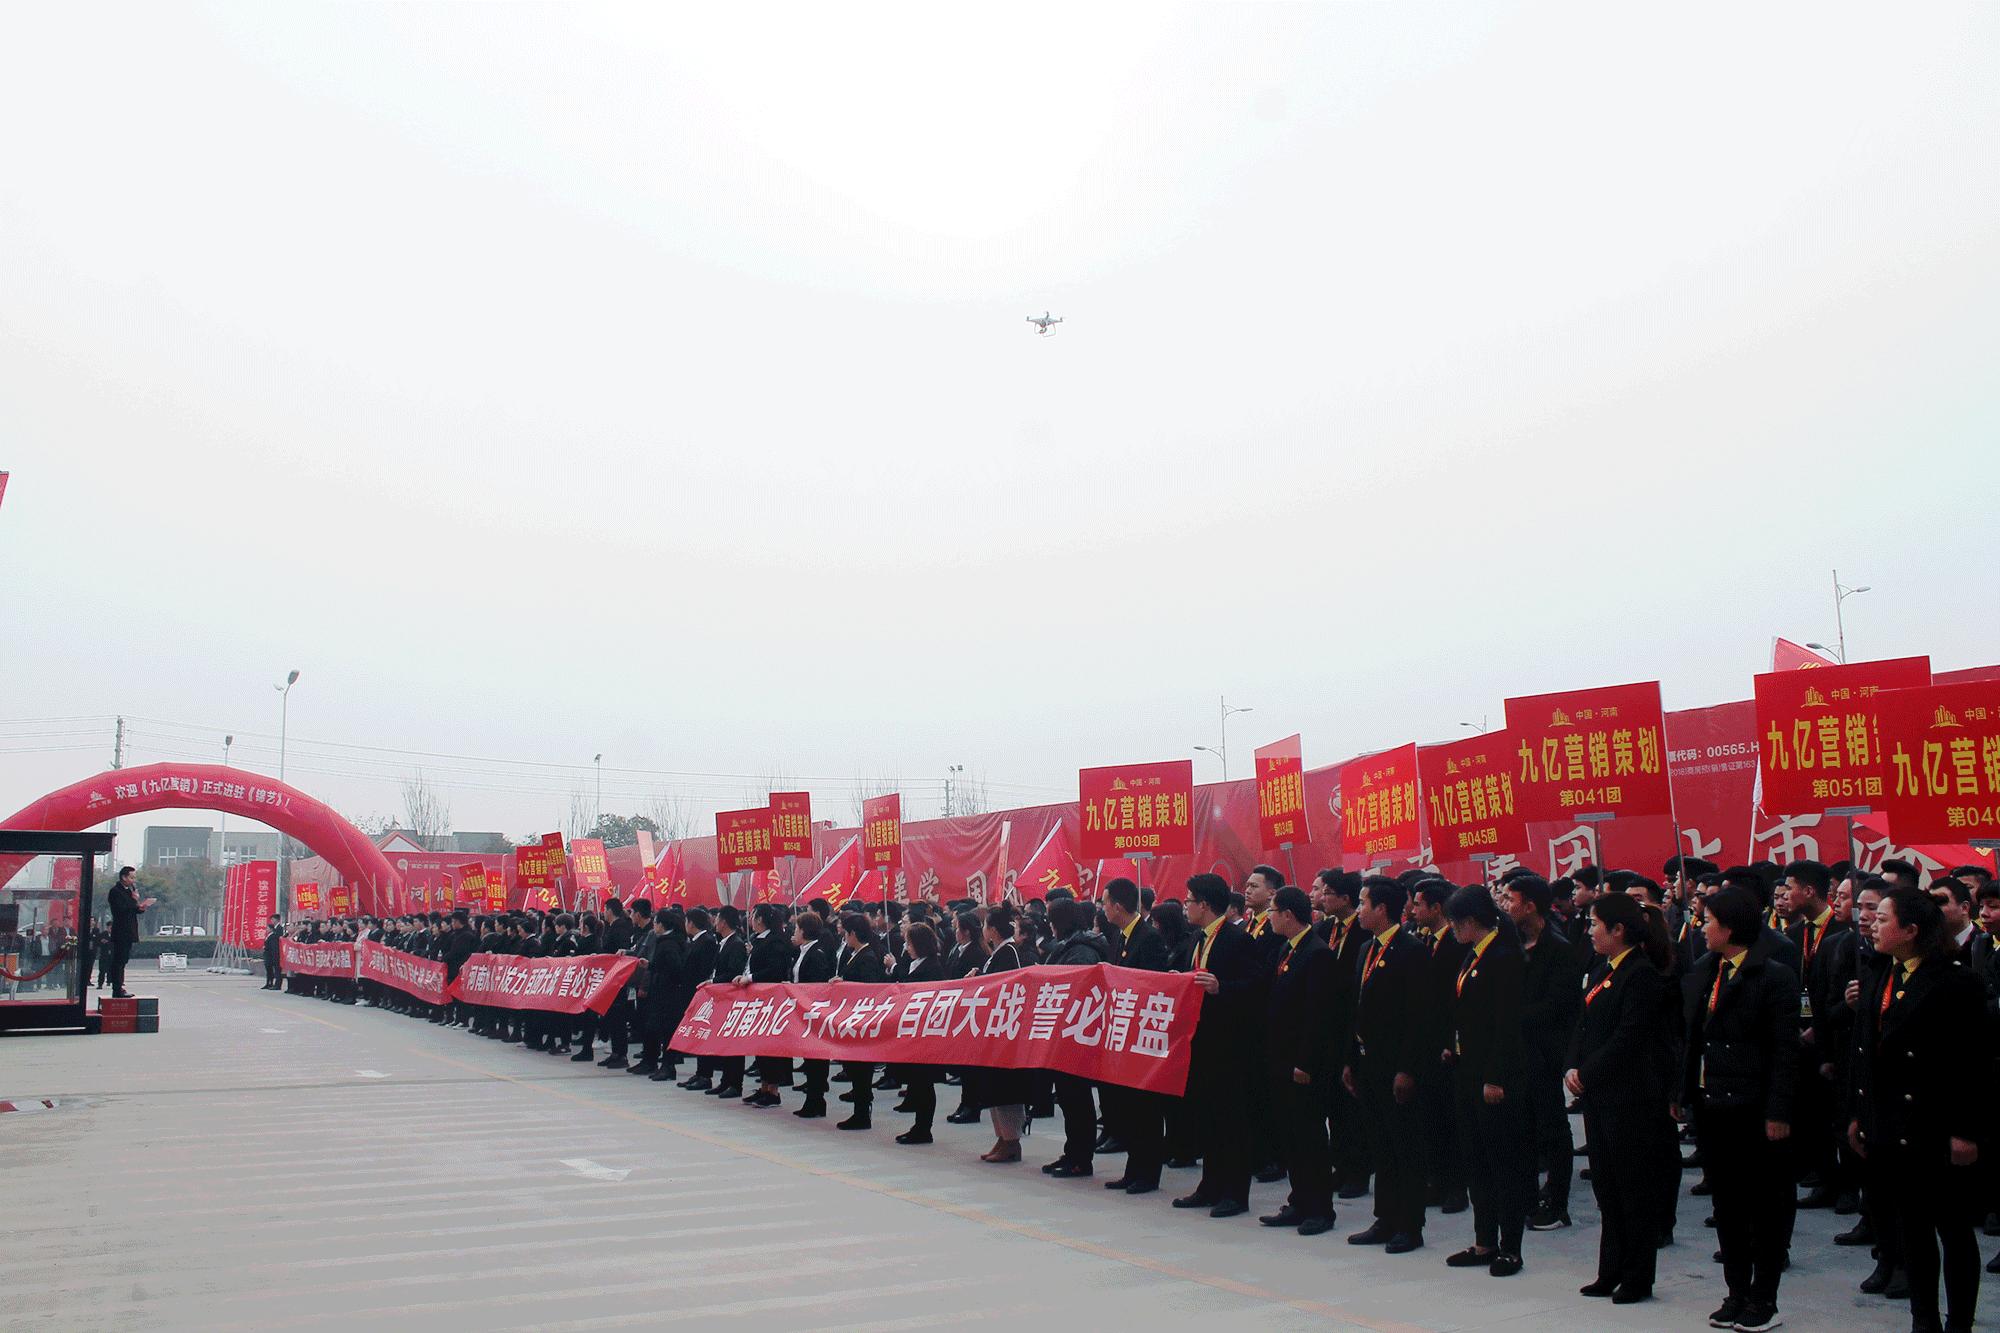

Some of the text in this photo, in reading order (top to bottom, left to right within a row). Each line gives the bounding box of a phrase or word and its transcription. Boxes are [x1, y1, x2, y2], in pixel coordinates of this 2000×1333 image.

[1575, 706, 1618, 721] 中国·河南
[1964, 706, 2000, 722] 中国·
[1706, 740, 1760, 760] 00565.H
[1767, 712, 1881, 771] 九亿营销
[1518, 725, 1660, 785] 九亿营销策划
[1559, 786, 1622, 808] 第041团
[1812, 776, 1883, 799] 第051团
[1086, 791, 1188, 831] 九亿营销策划
[1346, 780, 1416, 838] 九亿营销策划
[1114, 834, 1160, 849] 第009团
[1365, 834, 1397, 856] 第059团
[1458, 827, 1498, 849] 第045团
[717, 982, 1176, 1059] 河南九亿 千人发力 百团大战 誓必清盘
